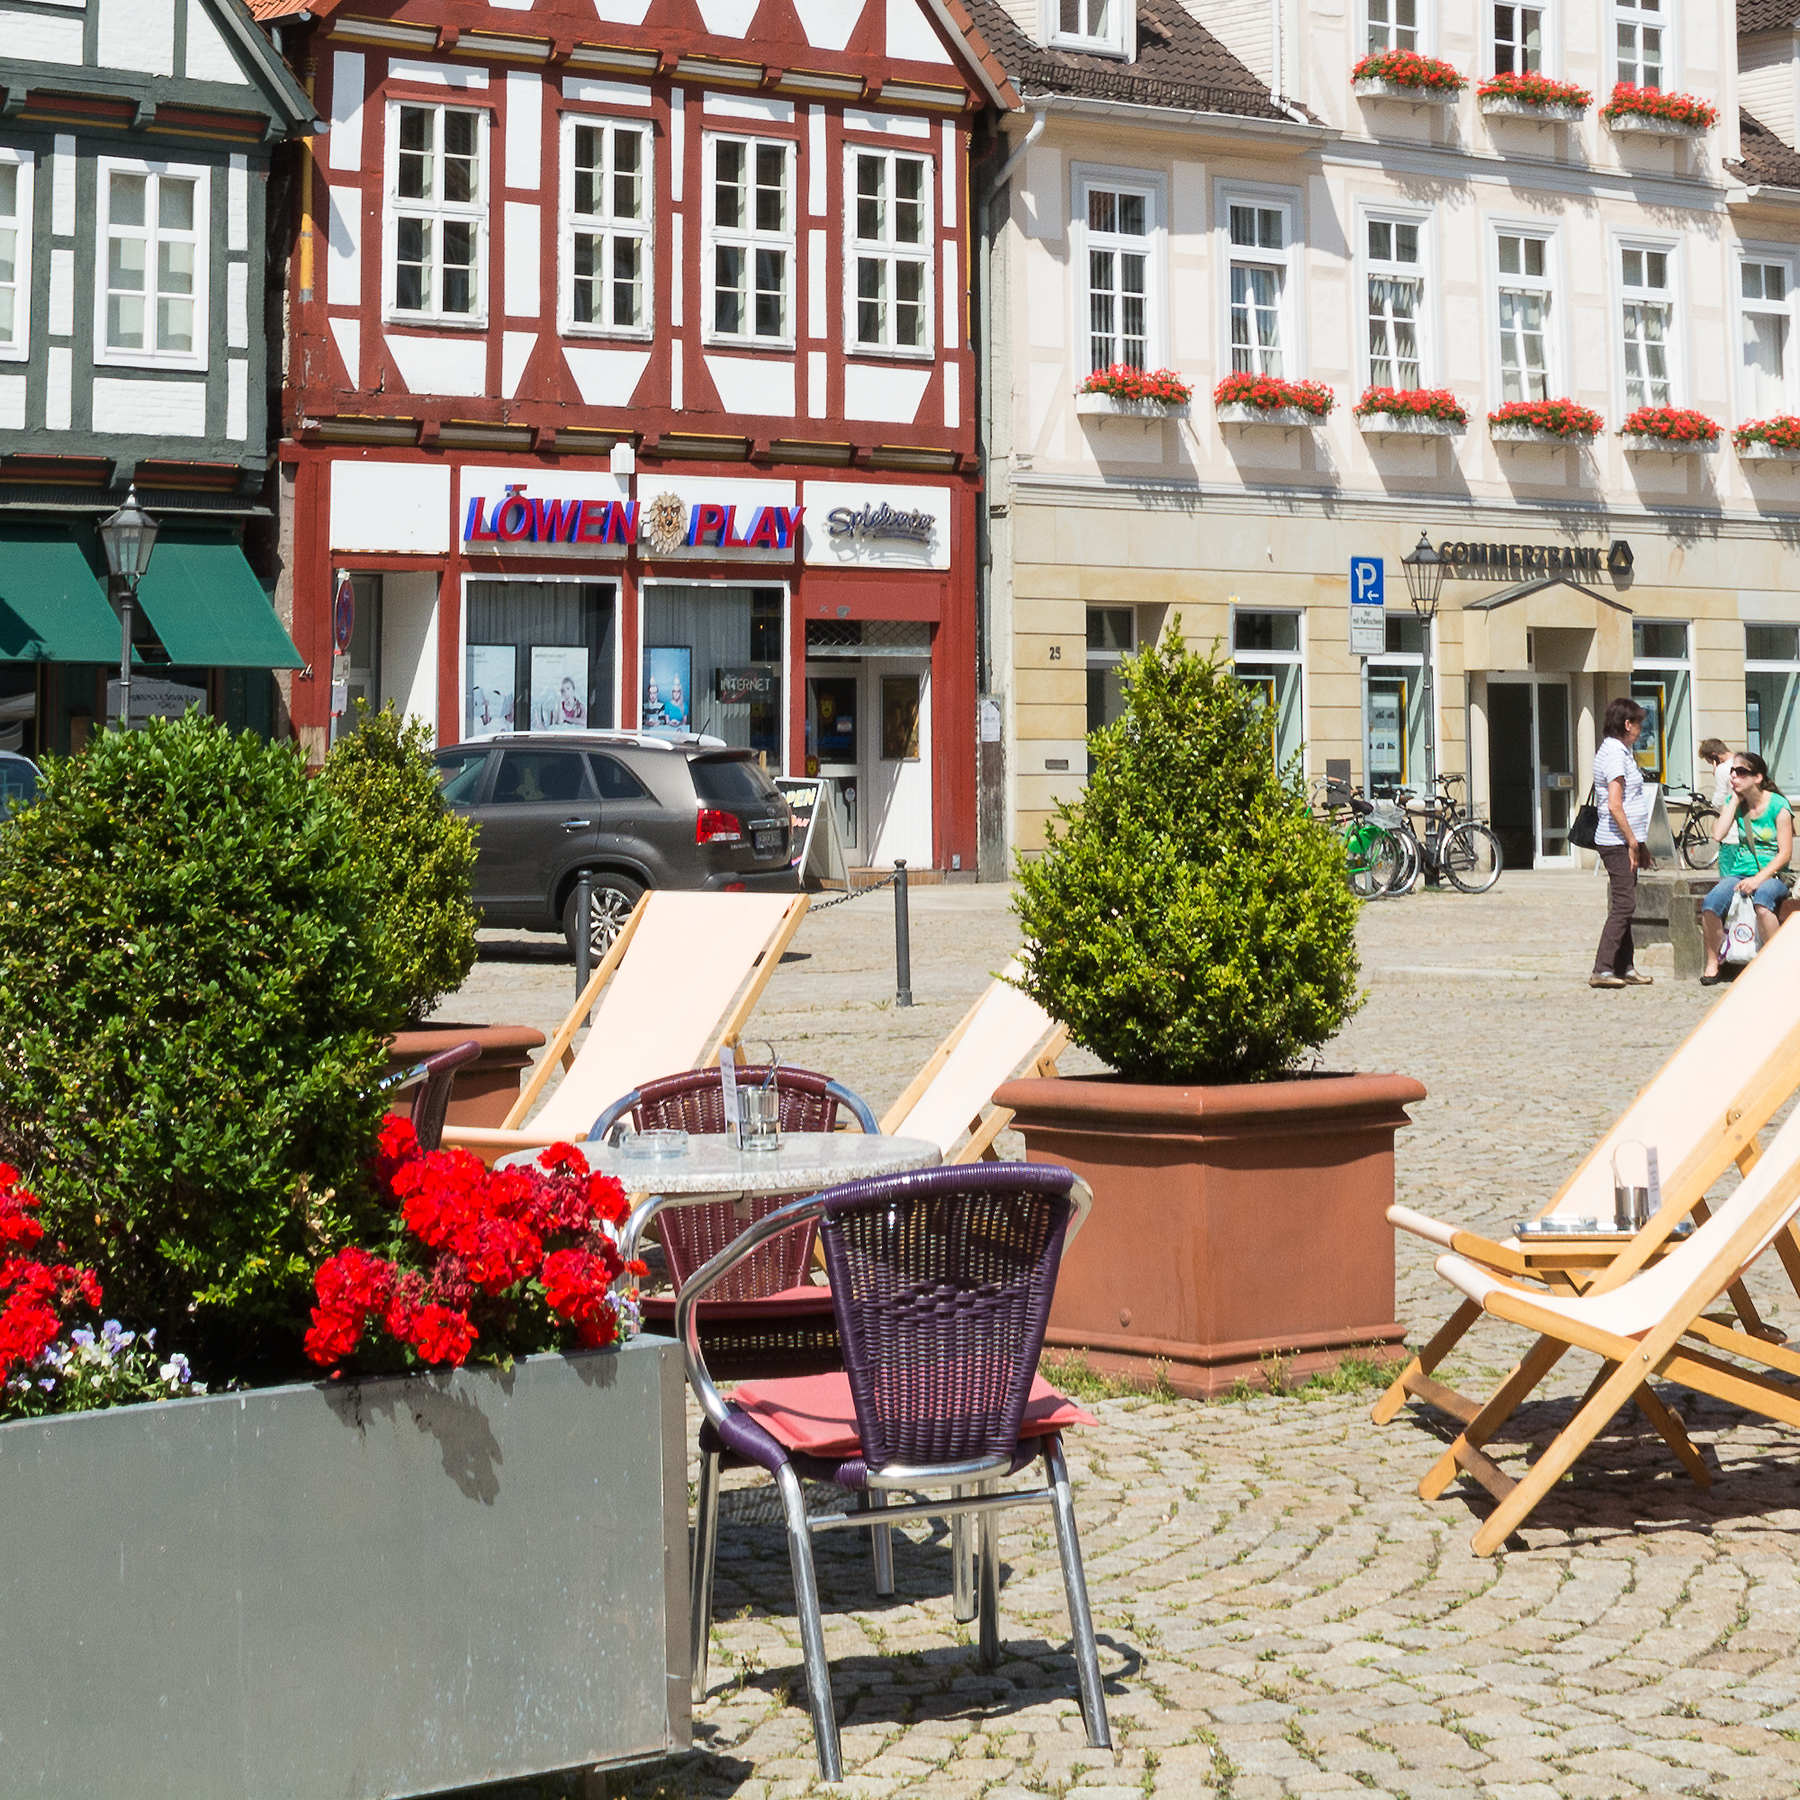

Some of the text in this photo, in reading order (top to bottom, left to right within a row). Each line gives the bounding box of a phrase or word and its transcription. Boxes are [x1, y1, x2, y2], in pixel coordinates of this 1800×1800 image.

[464, 484, 808, 549] LÖWEN PLAY
[1439, 541, 1602, 570] COMMERZBANK
[1358, 562, 1377, 599] P
[1049, 645, 1061, 661] 25
[720, 678, 771, 692] INTERNET
